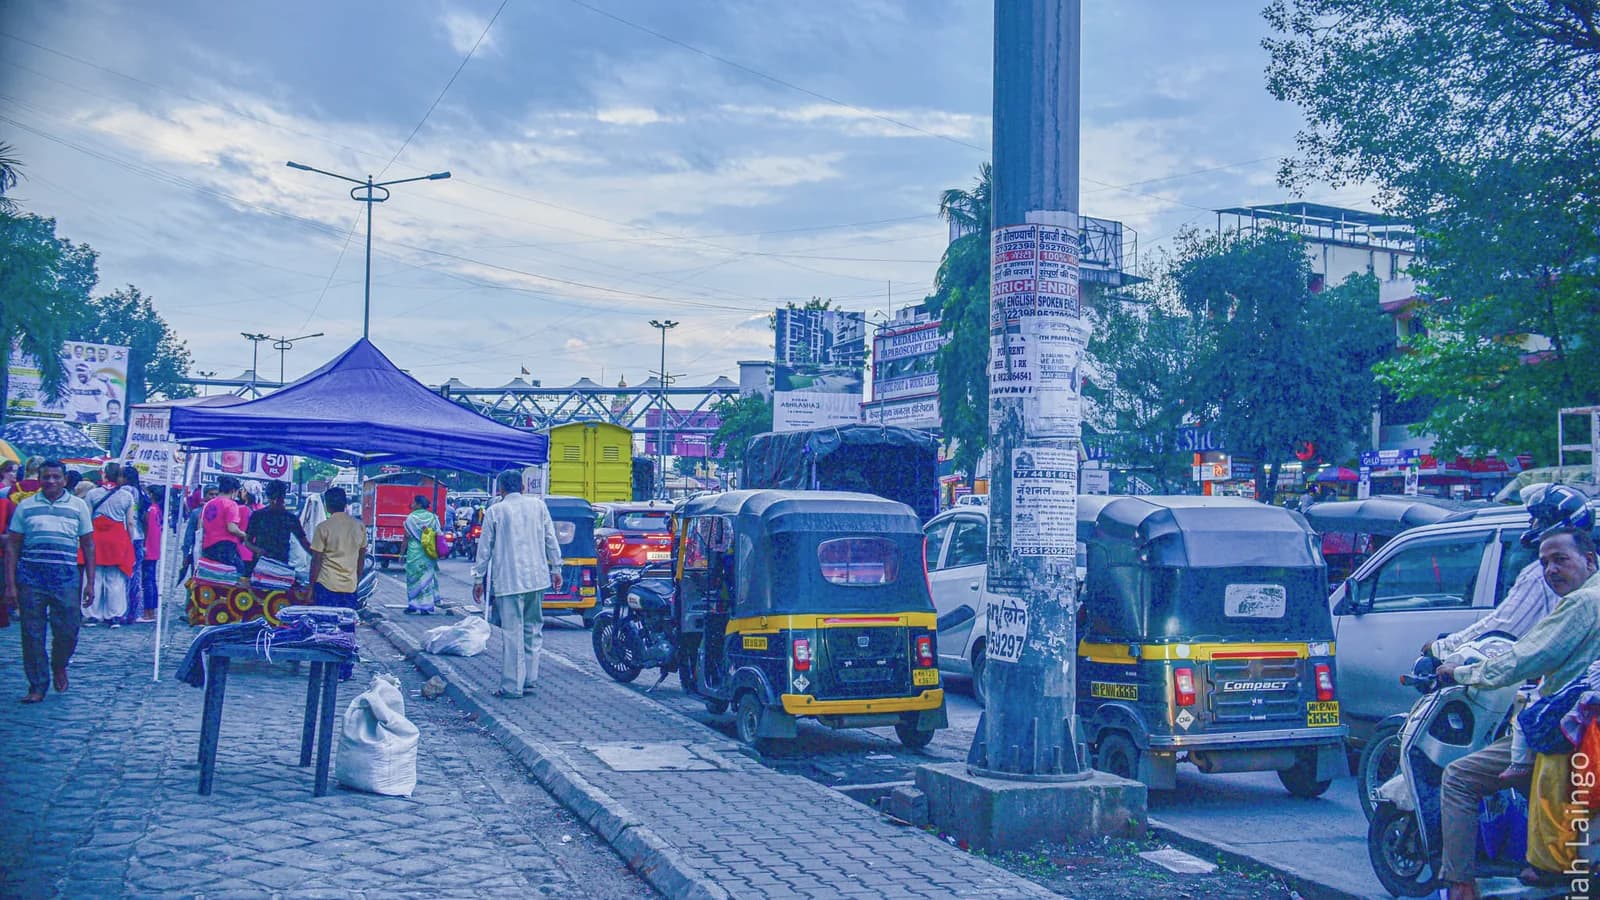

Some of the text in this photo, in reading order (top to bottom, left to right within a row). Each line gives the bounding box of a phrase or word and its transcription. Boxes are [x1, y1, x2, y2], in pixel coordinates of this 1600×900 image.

[1039, 281, 1077, 296] ENRIC
[1008, 294, 1035, 308] ENGLISH
[1038, 295, 1063, 309] SPOKEN
[893, 329, 937, 346] KEDARNATH
[132, 432, 158, 442] GORILLA
[266, 454, 285, 467] 50
